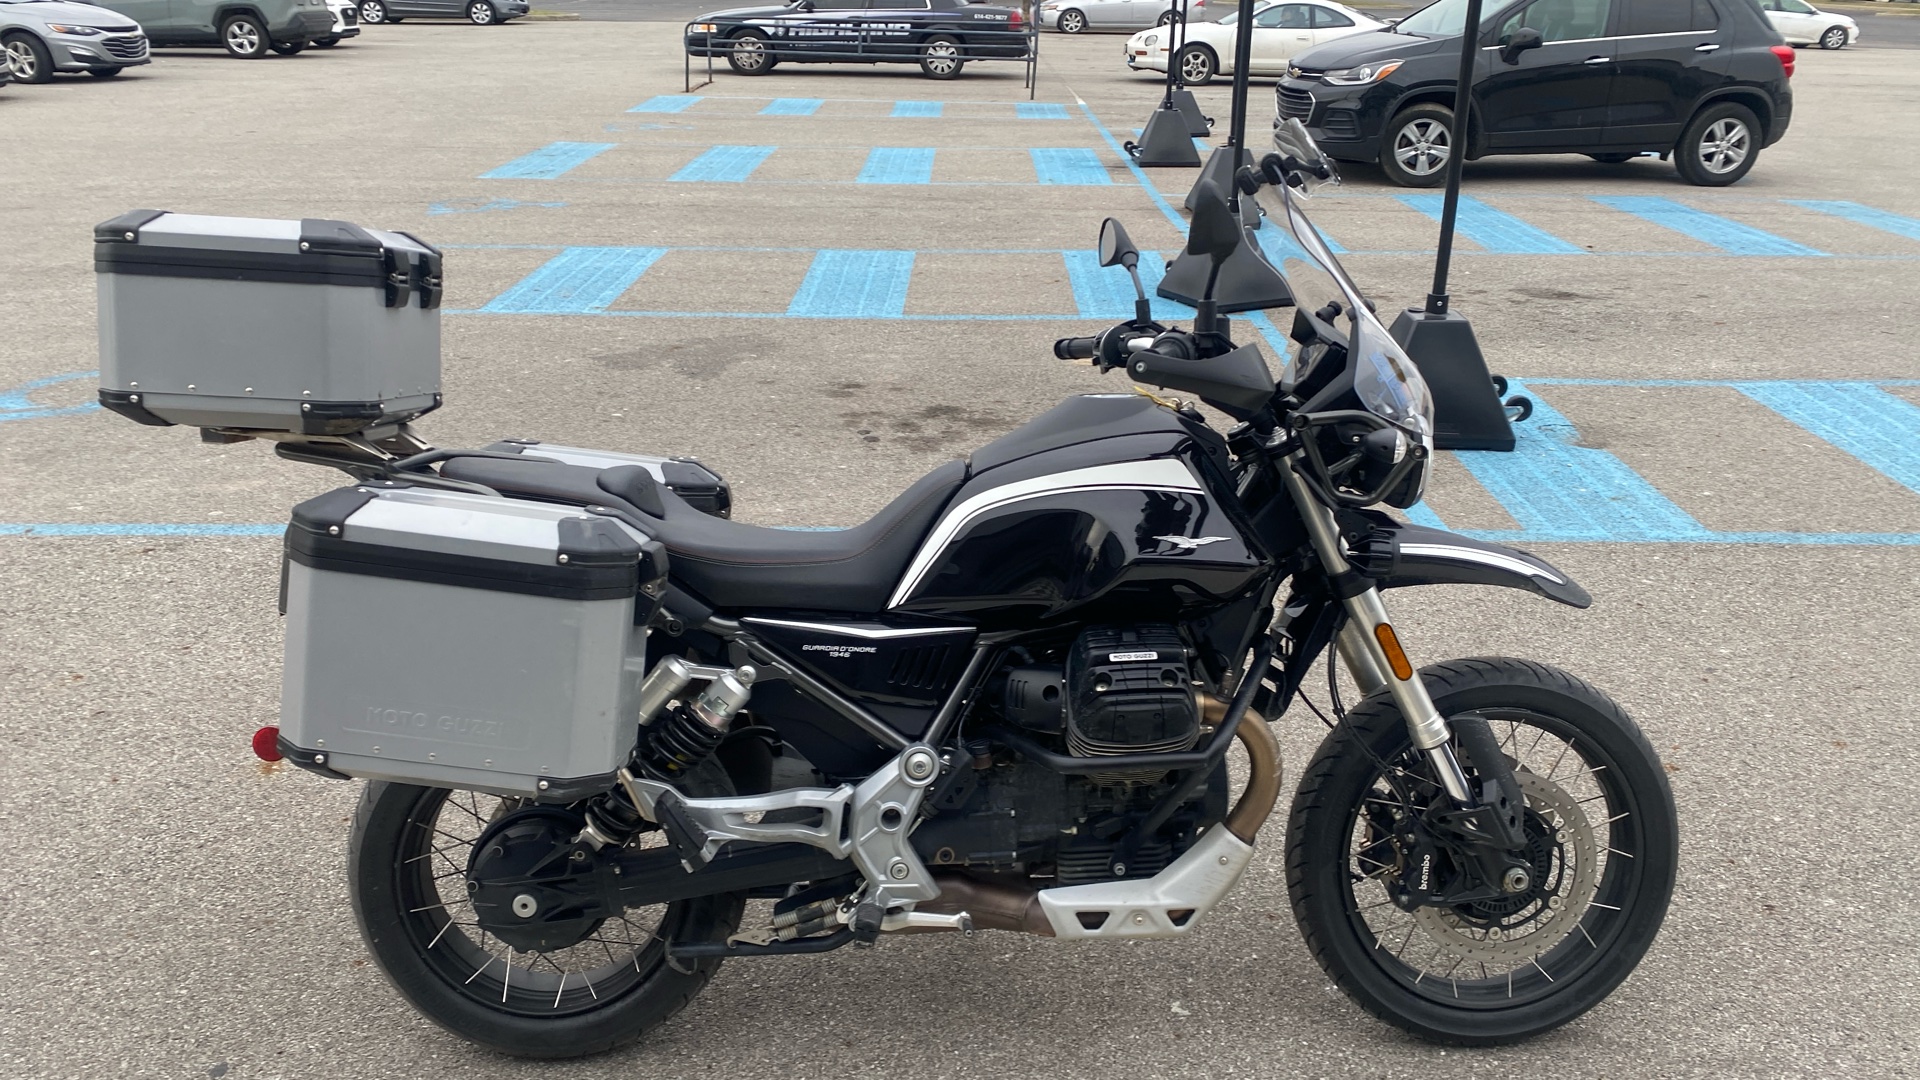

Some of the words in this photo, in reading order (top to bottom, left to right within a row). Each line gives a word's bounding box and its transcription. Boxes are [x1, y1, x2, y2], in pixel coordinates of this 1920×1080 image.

[802, 644, 840, 652] GUARDIA
[366, 706, 428, 728] MOTO
[437, 715, 505, 738] GUZZI
[1418, 854, 1431, 890] brembo
